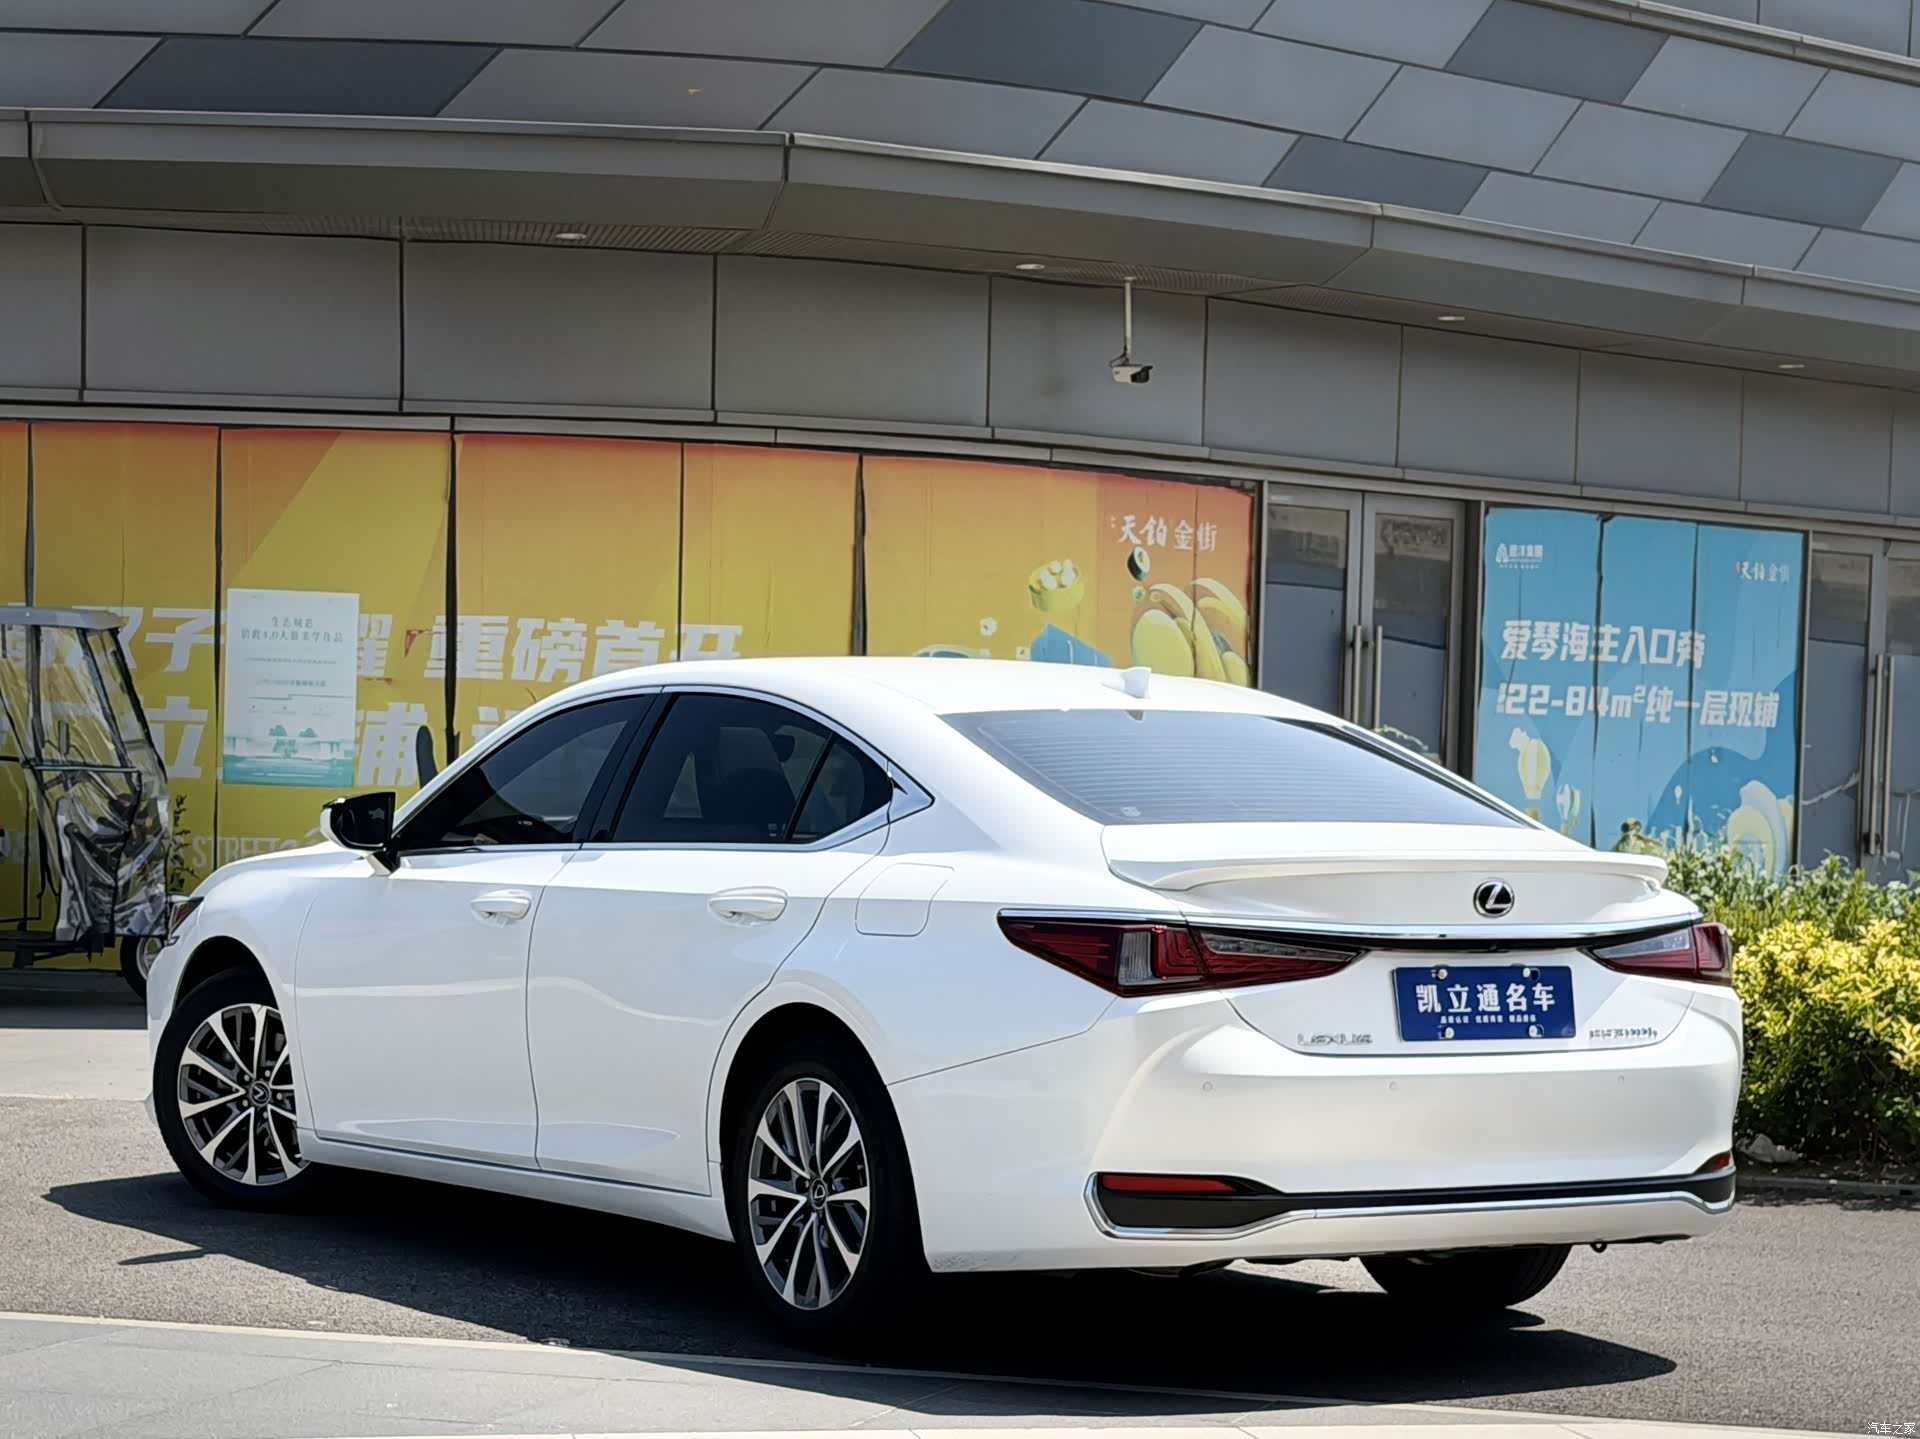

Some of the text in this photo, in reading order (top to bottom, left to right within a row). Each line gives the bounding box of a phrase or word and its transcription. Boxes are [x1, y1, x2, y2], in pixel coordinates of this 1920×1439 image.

[424, 615, 743, 683] 重磅首开
[1415, 983, 1556, 1014] 凯立通名车
